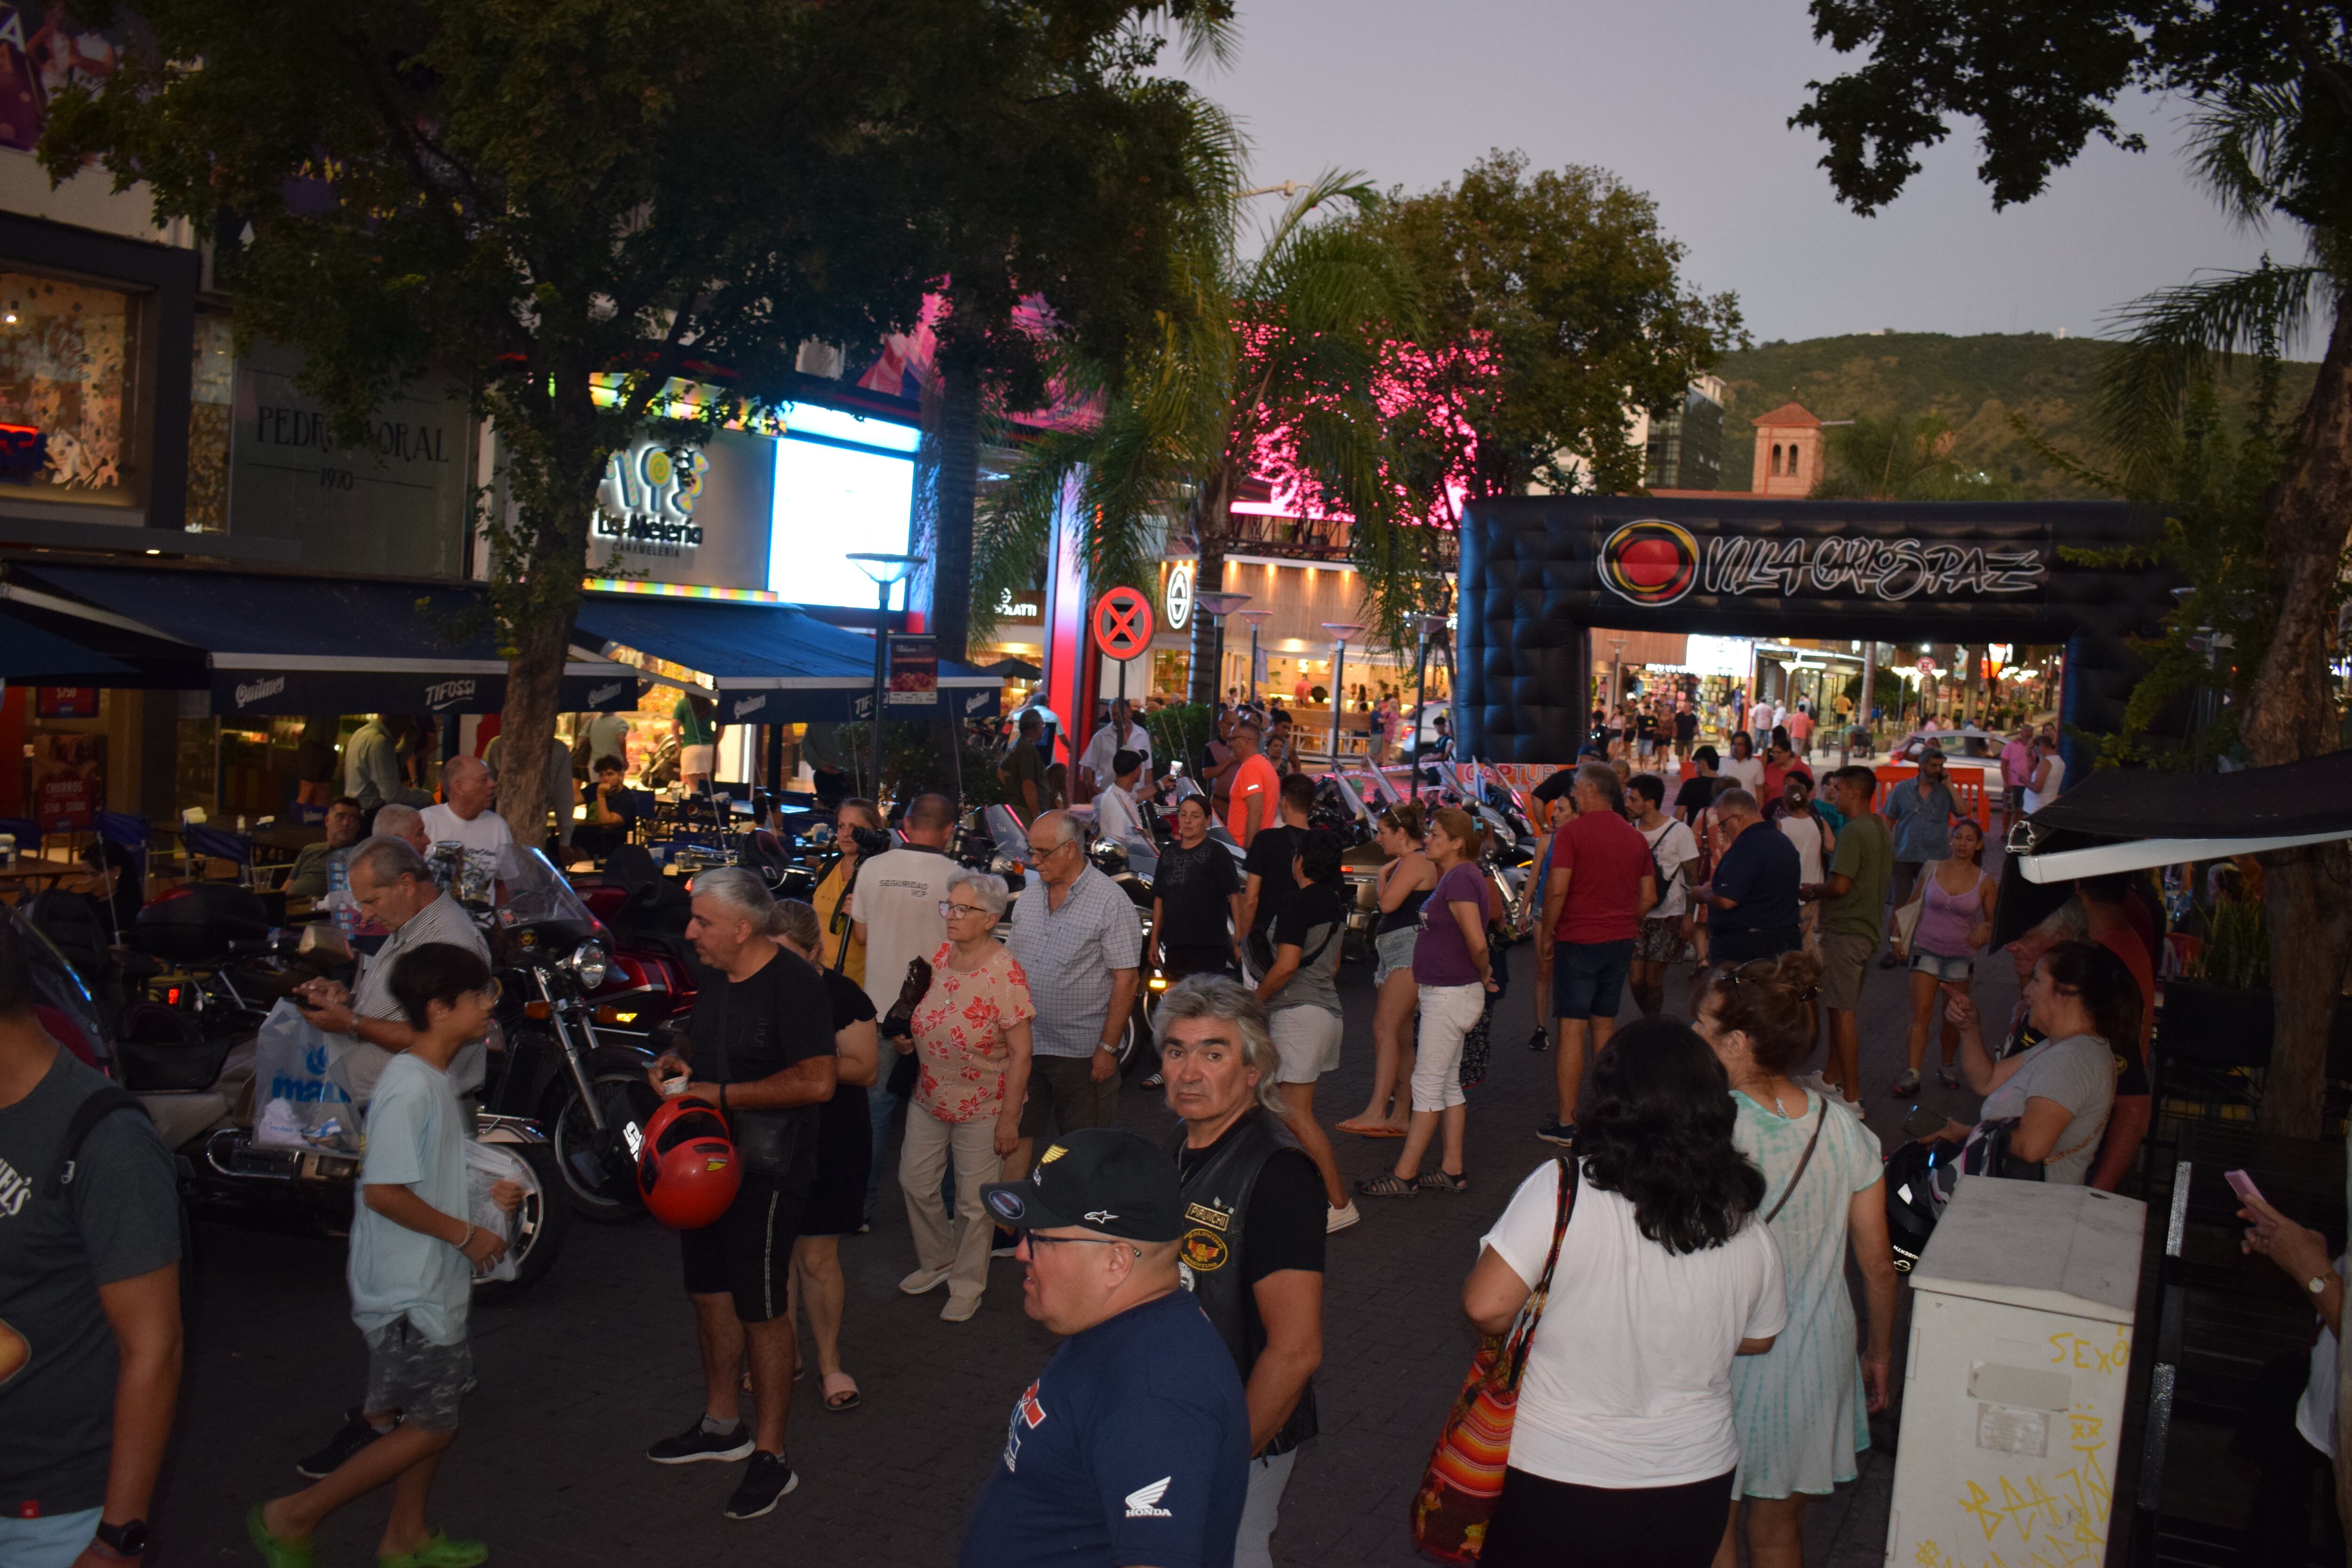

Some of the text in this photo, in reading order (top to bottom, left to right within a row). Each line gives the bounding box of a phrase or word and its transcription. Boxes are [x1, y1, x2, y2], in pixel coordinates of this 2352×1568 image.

[257, 406, 450, 462] PEDR ORAL
[320, 468, 353, 491] 1970
[598, 508, 703, 544] La Melería
[1705, 536, 2045, 601] VILLA CARLOS PAZ
[235, 676, 285, 708] Quilmes
[425, 679, 476, 706] TIFOSSI
[879, 879, 927, 890] SEGURIDAD
[1190, 1206, 1226, 1227] PIRUNCHI
[1188, 1231, 1224, 1250] GOLDWING
[1183, 1253, 1217, 1269] ARGENTINO
[1125, 1508, 1172, 1518] HONDA
